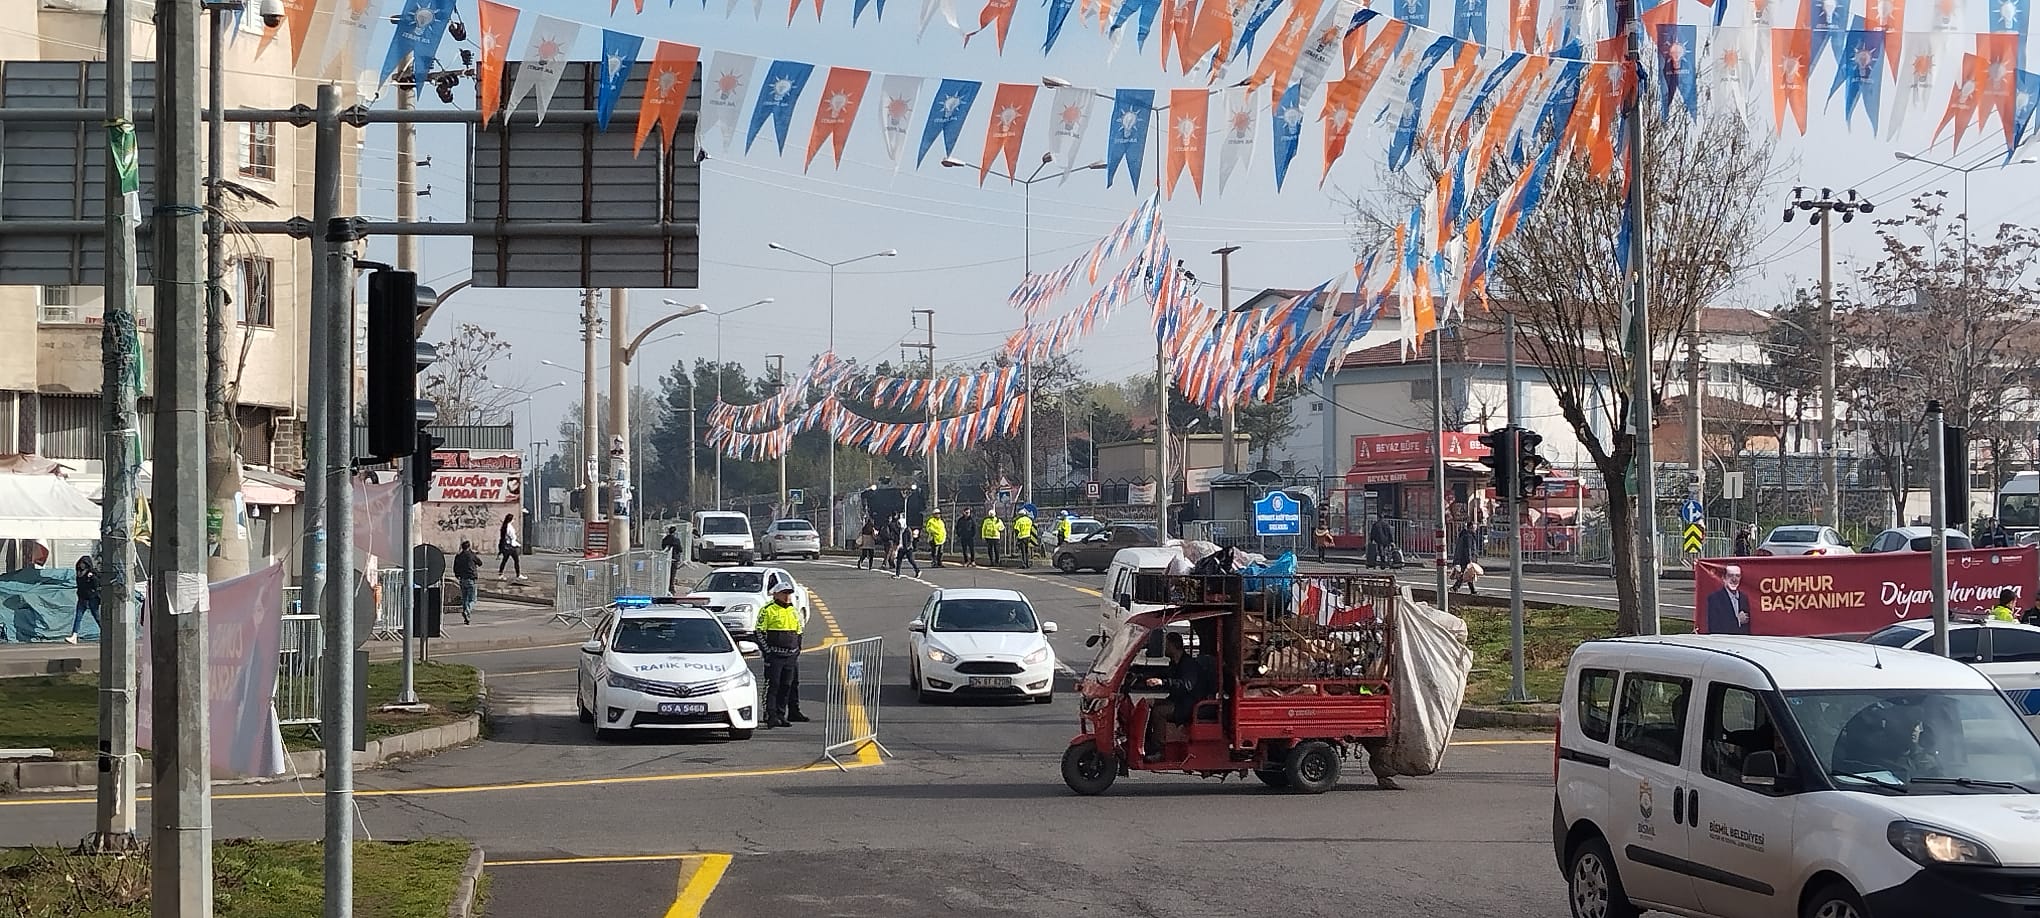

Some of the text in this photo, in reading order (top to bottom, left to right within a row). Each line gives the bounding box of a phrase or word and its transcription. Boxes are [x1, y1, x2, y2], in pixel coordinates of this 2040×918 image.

[1375, 442, 1400, 453] BEYAZ
[437, 474, 504, 488] KUAFÖR ve
[441, 488, 478, 499] MODA
[1760, 575, 1833, 593] CUMHUR
[1760, 591, 1866, 613] BAŞKANIMIZ
[633, 661, 679, 673] TRAFİK
[661, 704, 673, 712] 05
[674, 704, 682, 712] A
[1730, 827, 1765, 845] BELEDİYESİ
